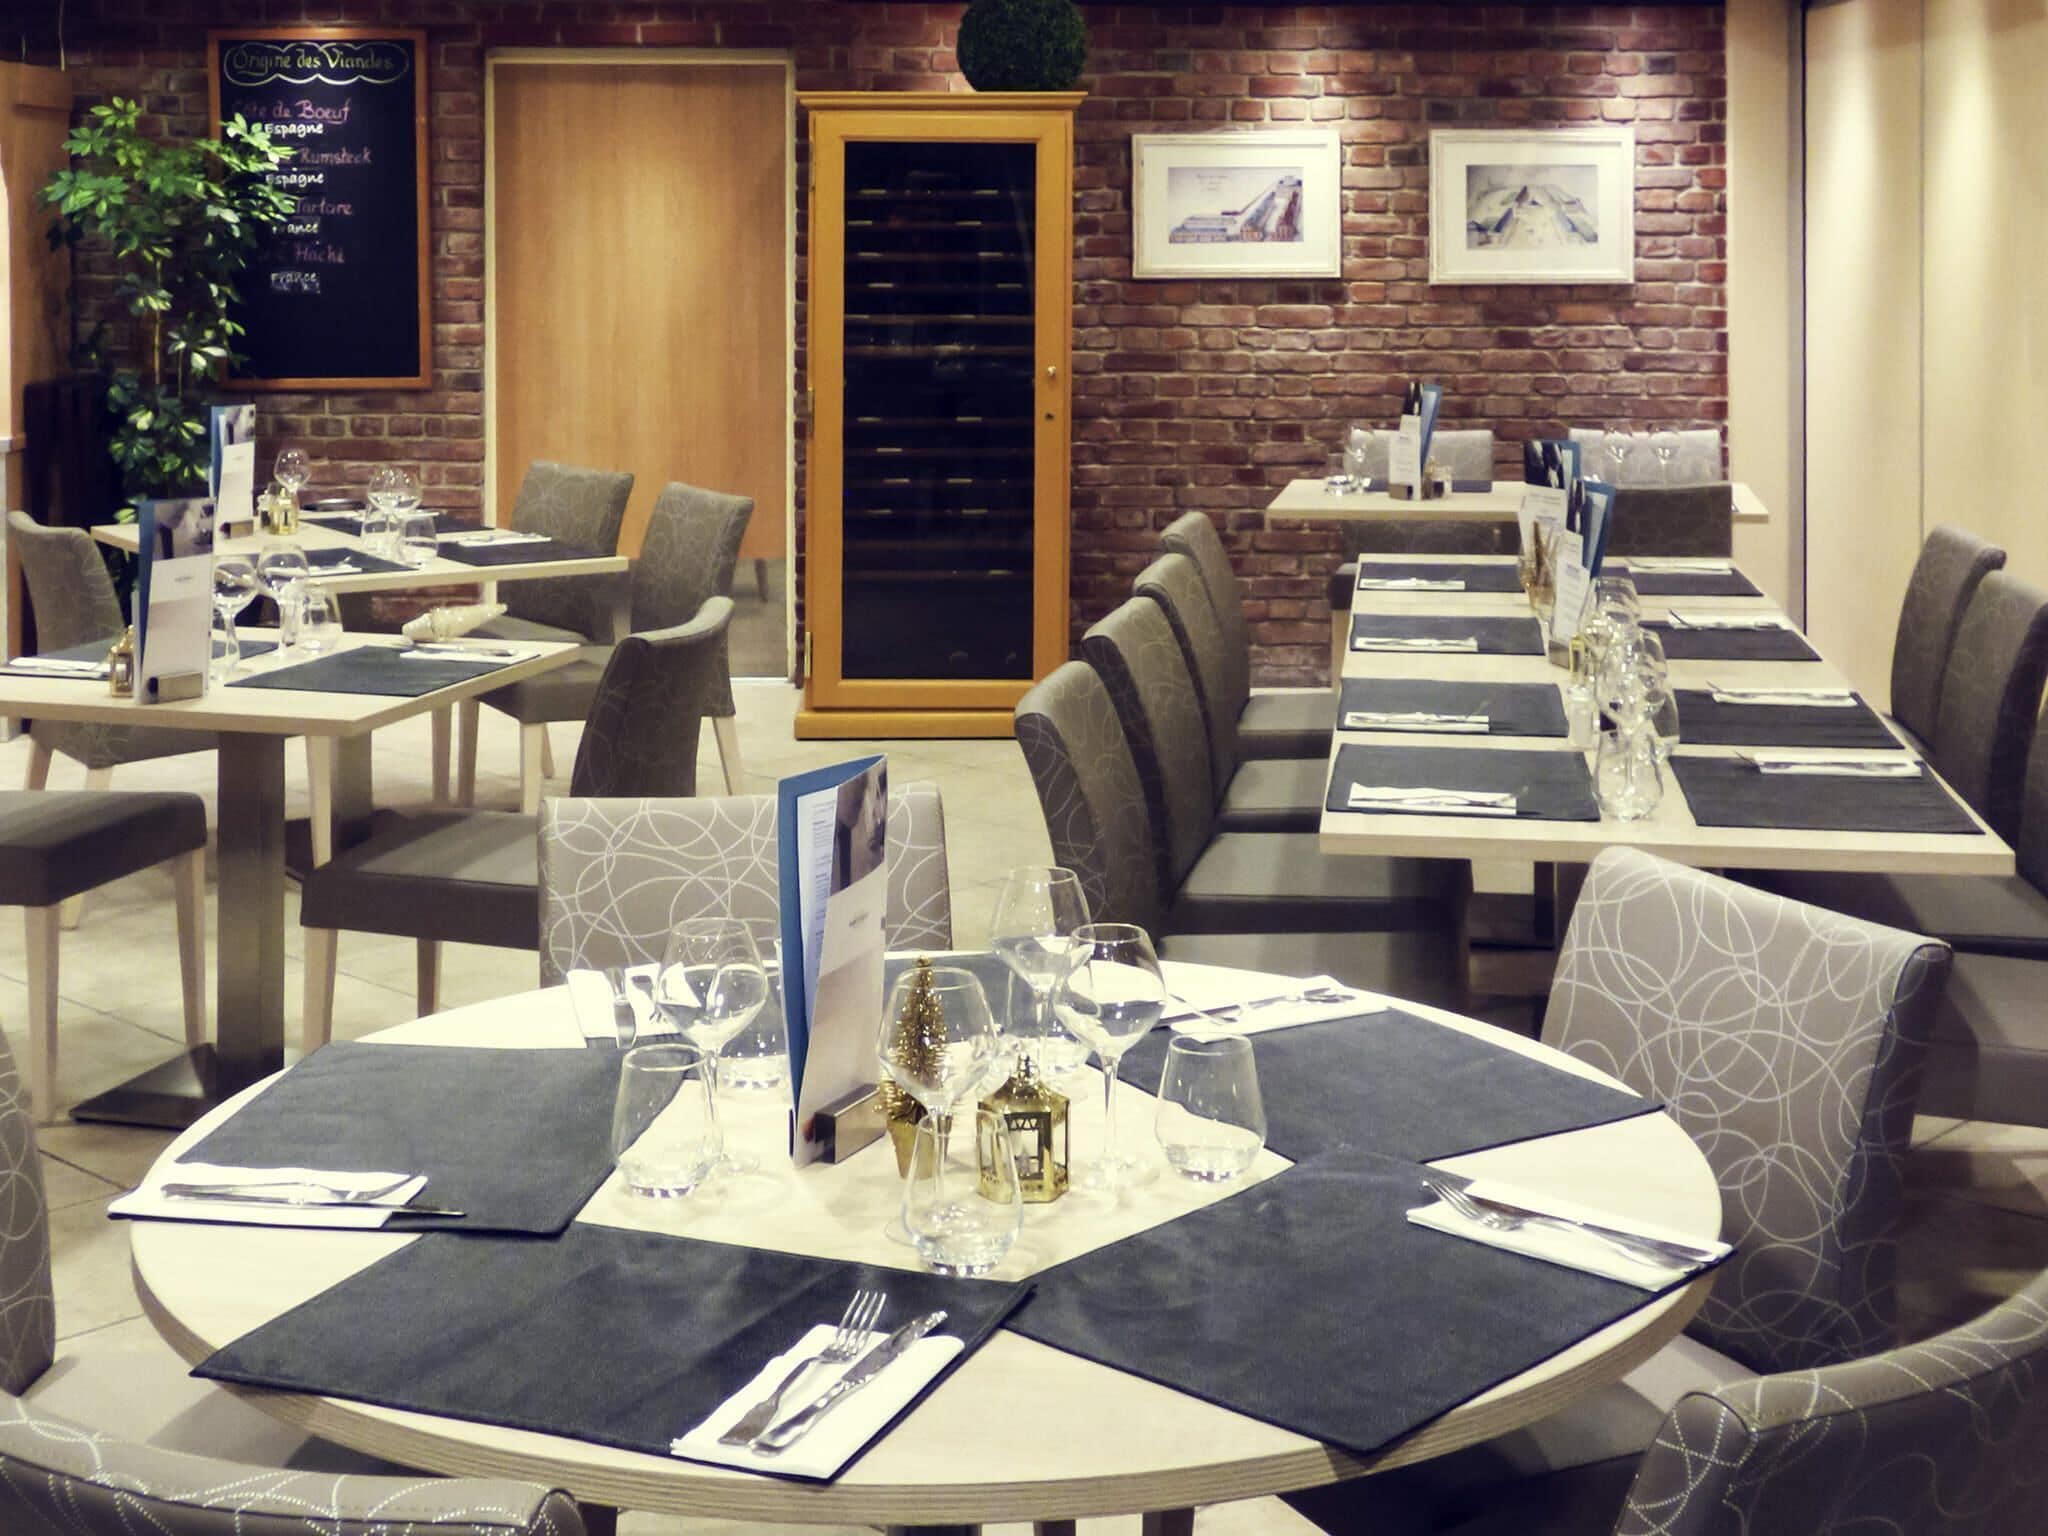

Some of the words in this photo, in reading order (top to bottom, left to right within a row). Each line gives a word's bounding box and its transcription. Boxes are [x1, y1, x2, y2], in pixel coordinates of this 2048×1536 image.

[233, 49, 291, 76] Origine
[296, 48, 321, 68] des
[319, 48, 393, 68] Viandes
[264, 123, 324, 139] Espagne
[265, 172, 325, 189] Espagne
